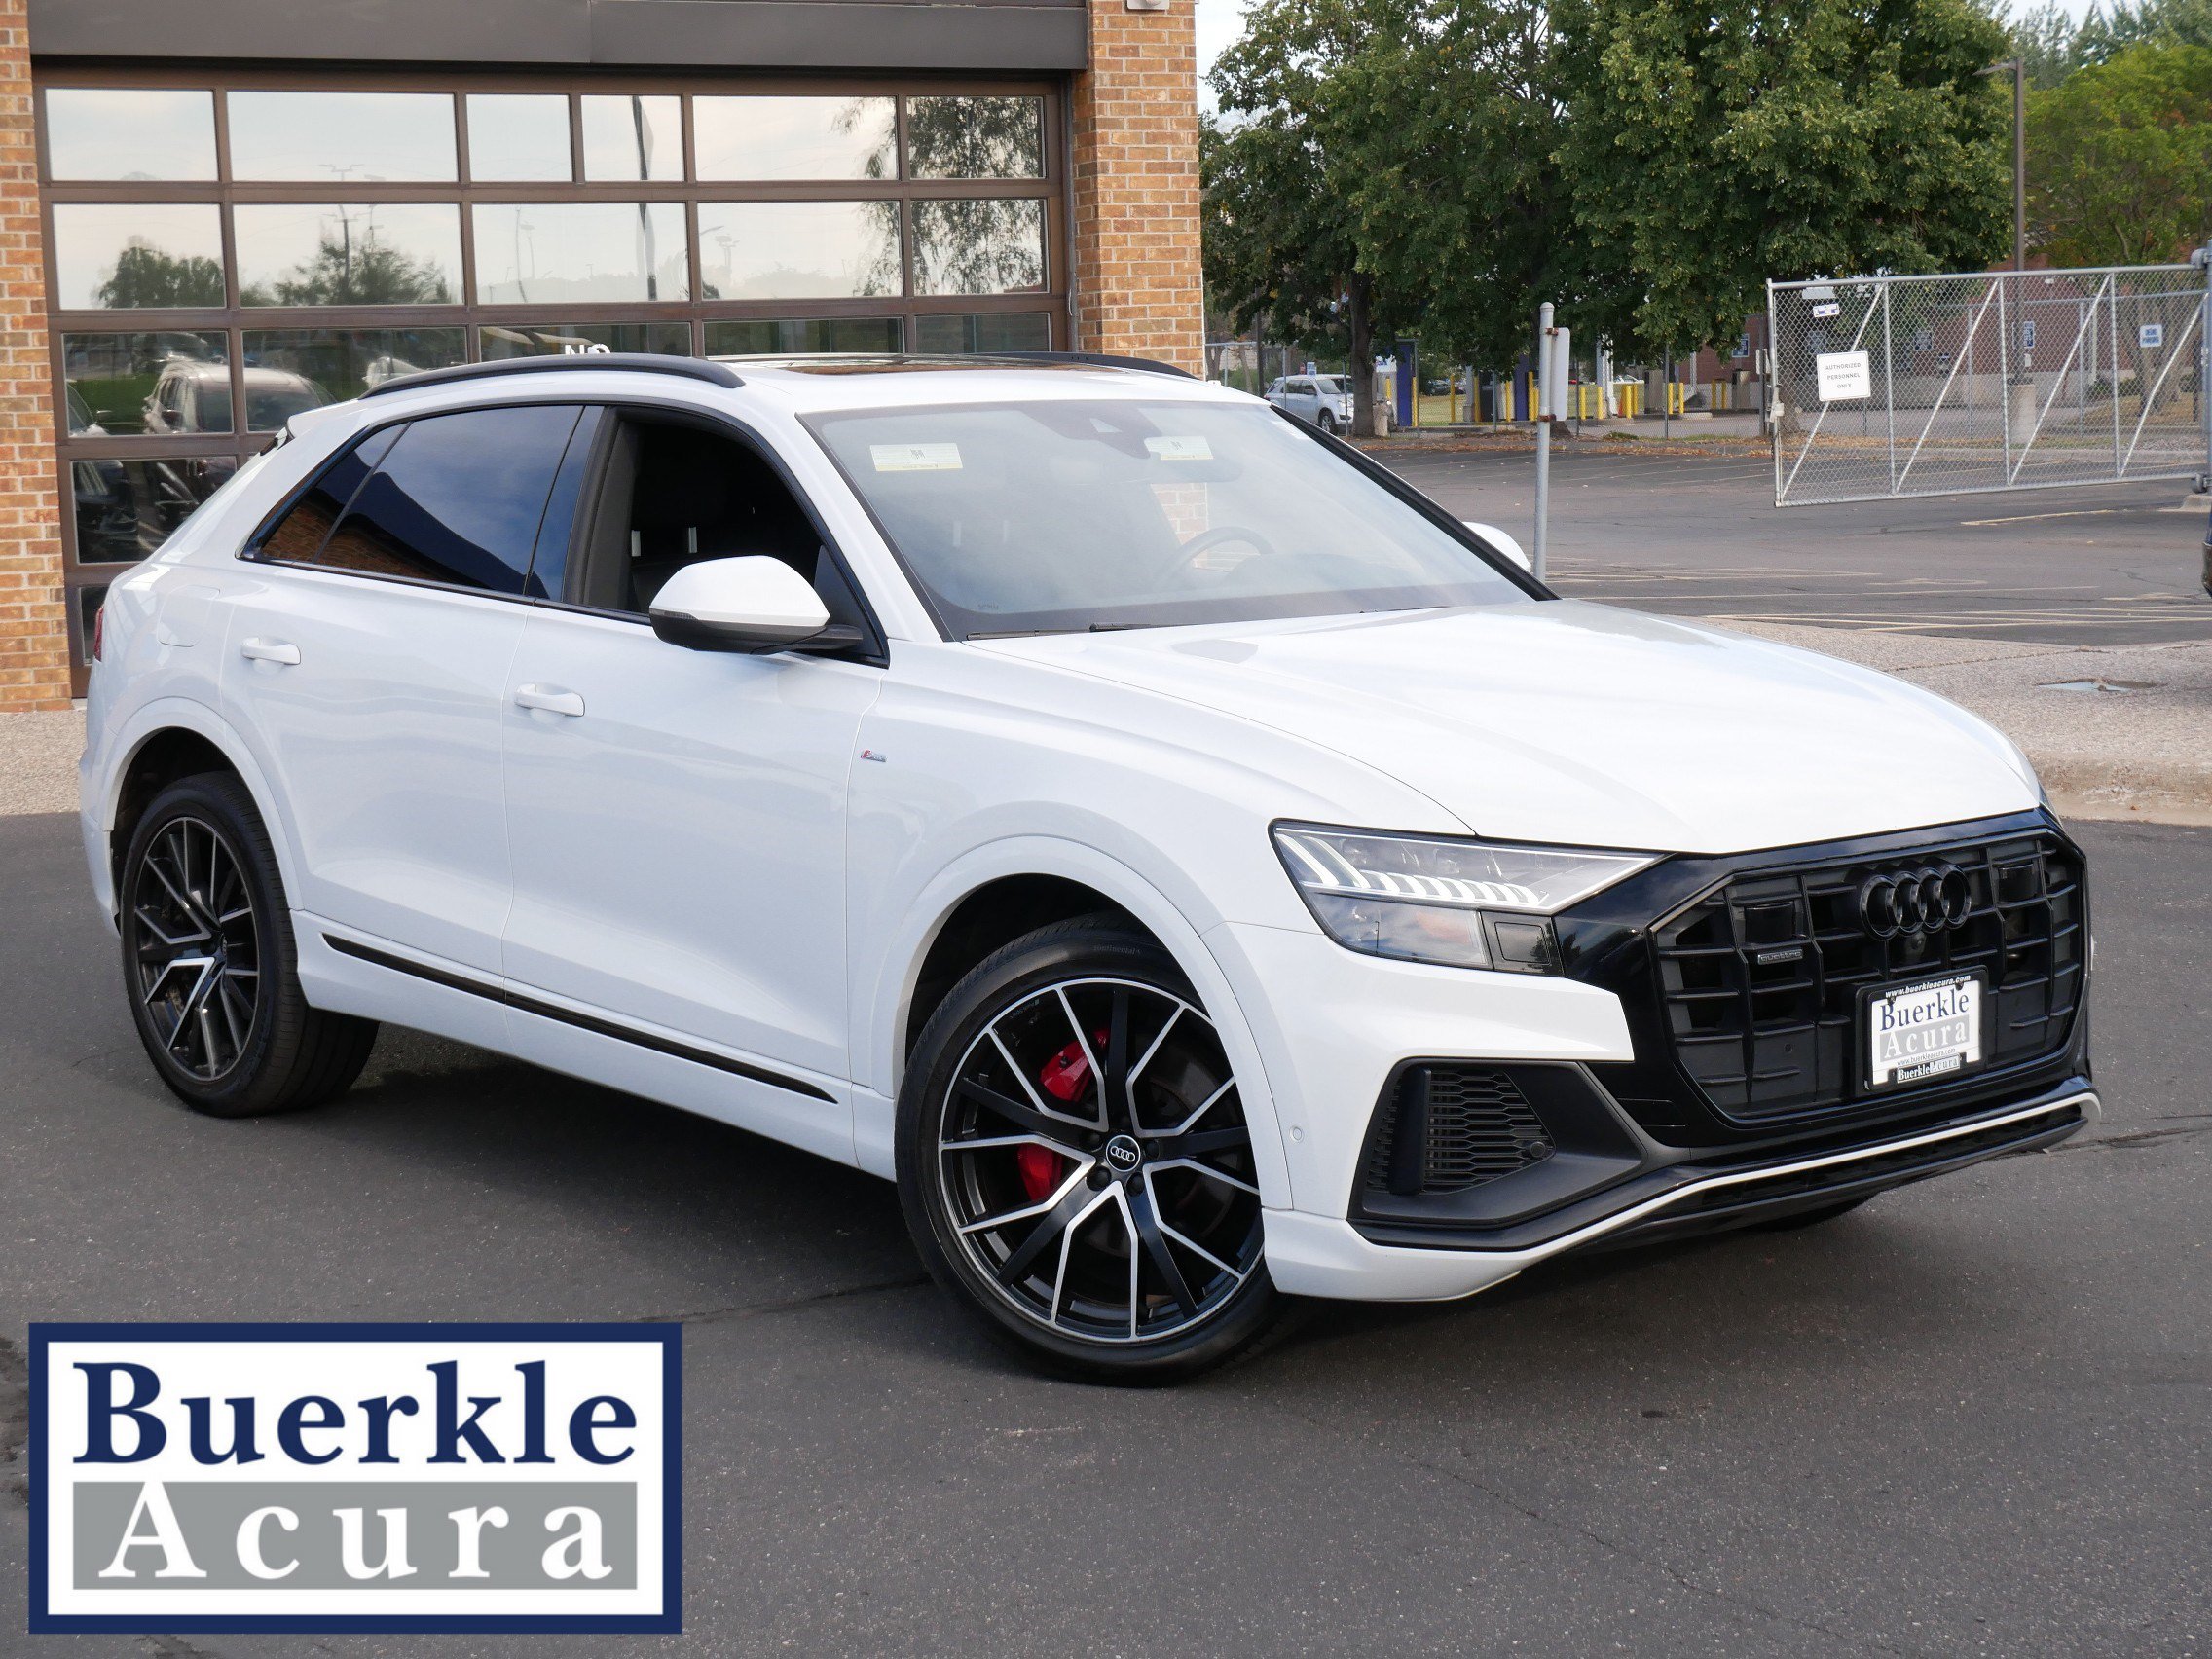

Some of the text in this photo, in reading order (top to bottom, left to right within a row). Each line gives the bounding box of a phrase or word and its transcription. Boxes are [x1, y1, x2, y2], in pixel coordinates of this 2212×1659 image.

[1826, 372, 1861, 381] PERSONNEL
[1885, 975, 1971, 998] www.buerkleacura.com
[1880, 988, 1969, 1031] Buerkle
[1884, 1021, 1967, 1059] Acura
